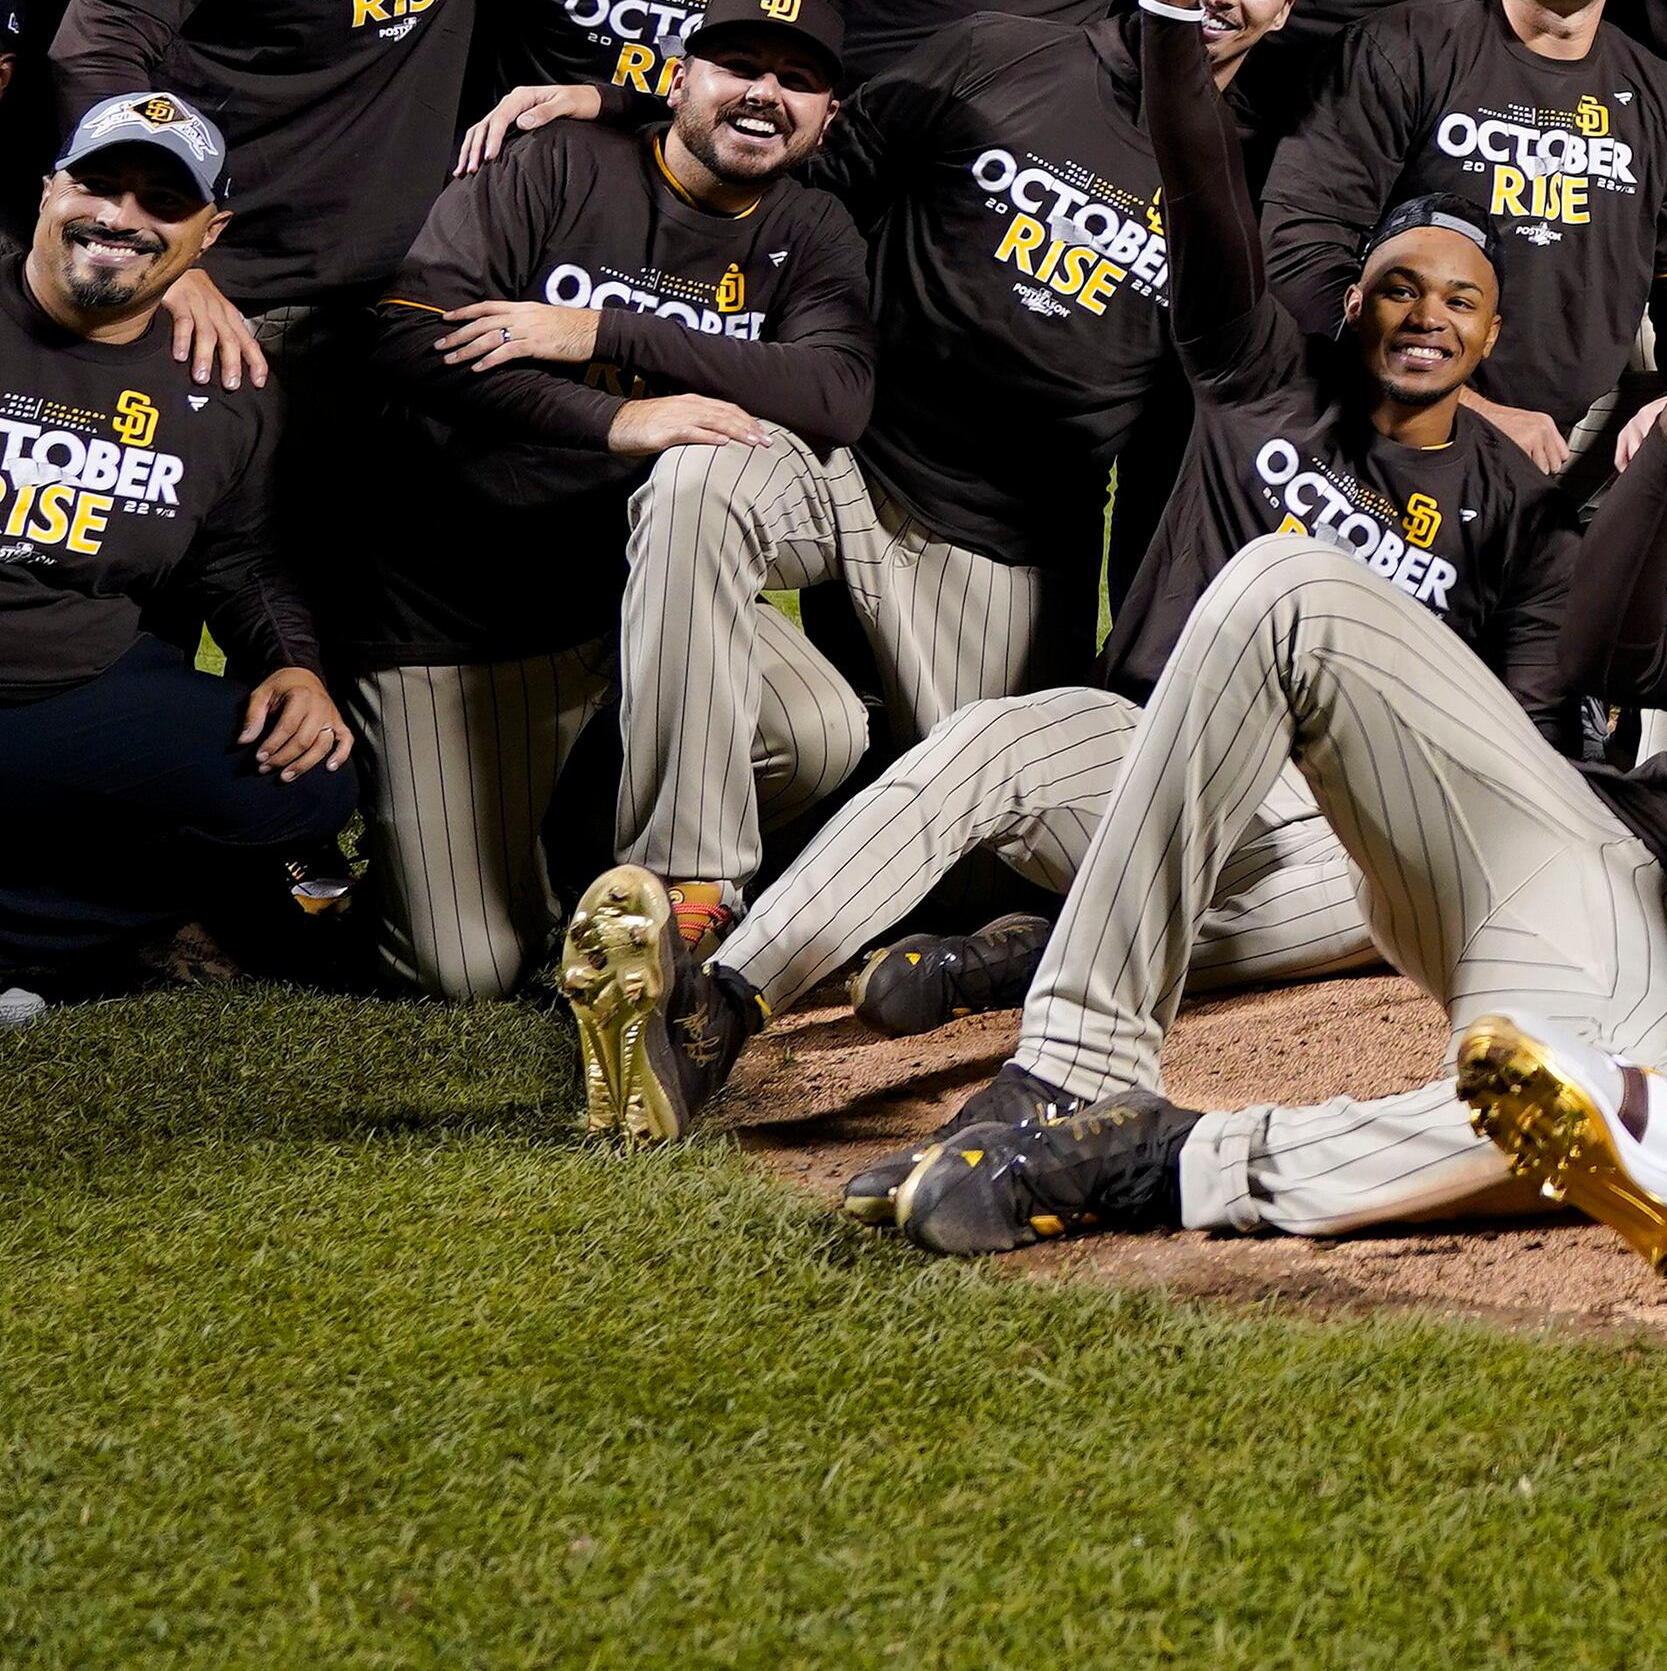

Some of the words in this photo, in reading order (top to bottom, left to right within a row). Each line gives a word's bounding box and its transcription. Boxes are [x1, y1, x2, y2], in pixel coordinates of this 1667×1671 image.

[1575, 94, 1610, 138] SD
[1435, 113, 1638, 185] OCTOBER
[1462, 160, 1485, 173] 20
[984, 198, 1009, 215] 20
[1490, 165, 1592, 225] RISE
[1597, 177, 1619, 191] 22
[715, 264, 746, 313] SD
[994, 212, 1127, 318] RISE
[1131, 279, 1153, 296] 22
[112, 389, 160, 447] SD
[124, 501, 149, 516] 22
[1254, 437, 1459, 613] OCTOBER
[1402, 491, 1441, 549] SD
